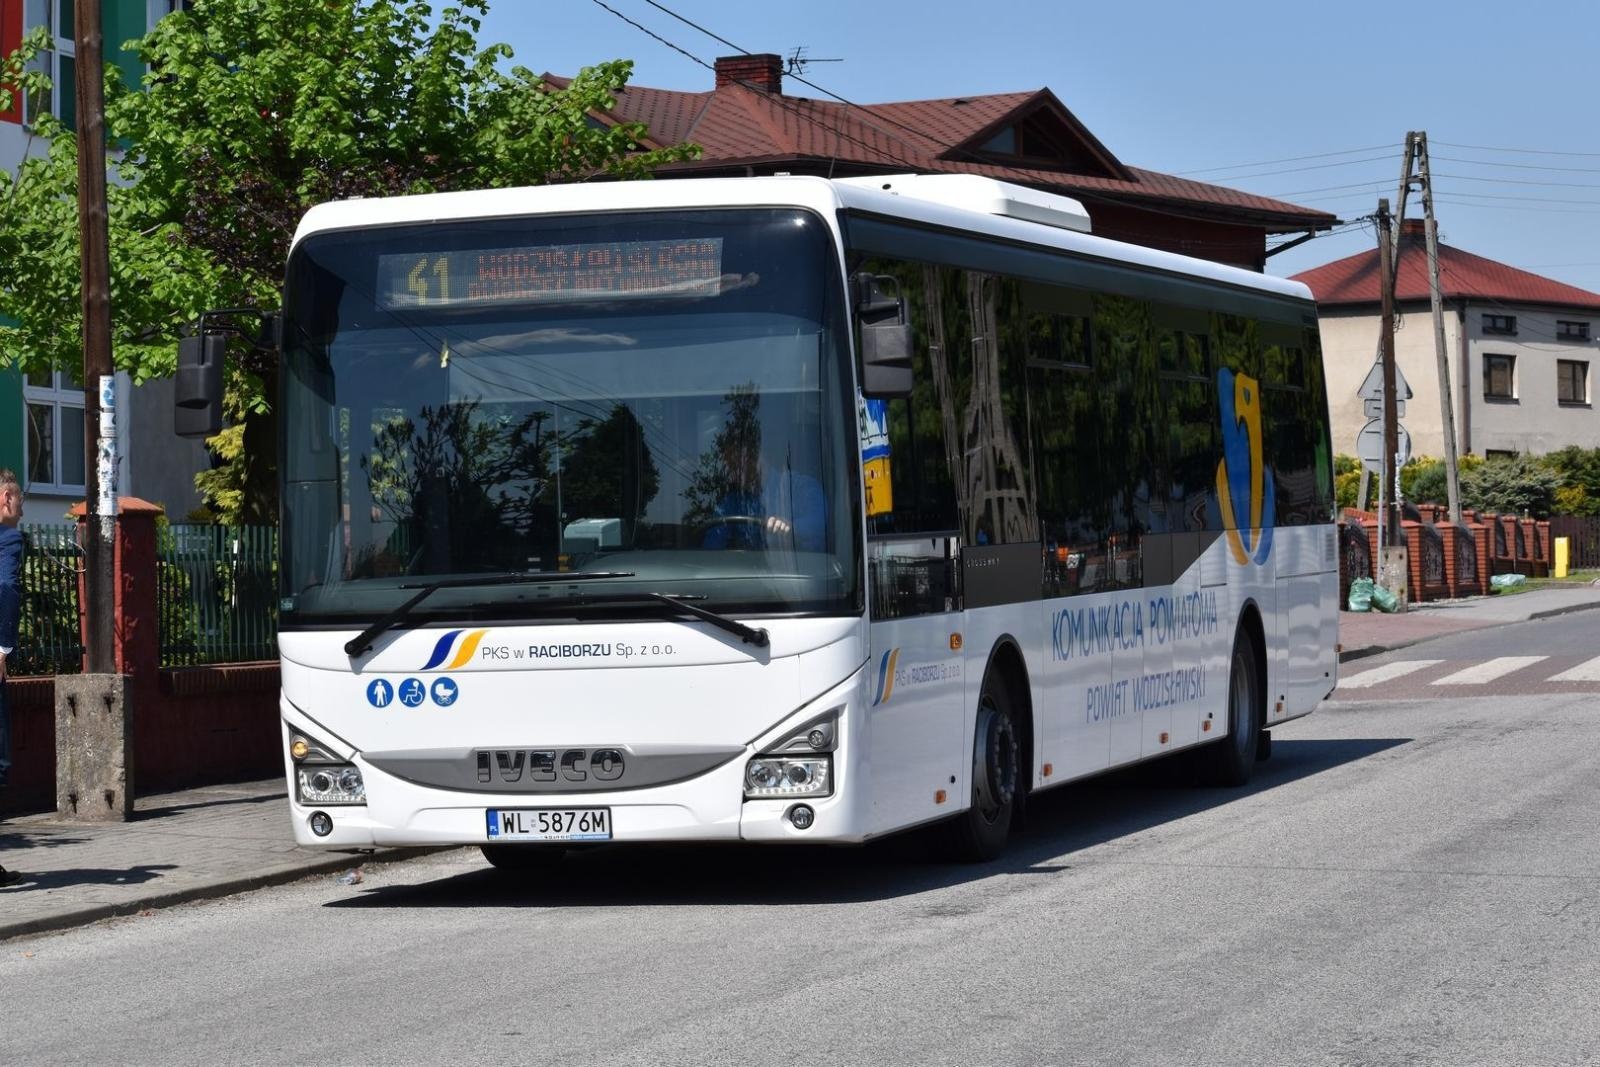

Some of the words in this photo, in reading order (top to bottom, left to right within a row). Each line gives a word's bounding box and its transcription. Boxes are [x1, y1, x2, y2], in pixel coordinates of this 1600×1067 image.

[408, 257, 450, 305] 41
[1052, 601, 1144, 662] KOMUNIKACJA
[1150, 591, 1218, 645] POWIATOWA
[482, 646, 510, 660] PKS
[513, 650, 525, 659] w
[528, 643, 612, 659] RACIBORZU
[615, 642, 637, 659] Sp.
[640, 646, 648, 656] z
[651, 644, 677, 656] o.o.
[1086, 680, 1128, 723] POWIAT
[1132, 664, 1206, 713] WODZISŁAWSKI
[476, 748, 626, 784] IVECO
[502, 812, 530, 834] WL
[538, 811, 605, 833] 5876M
